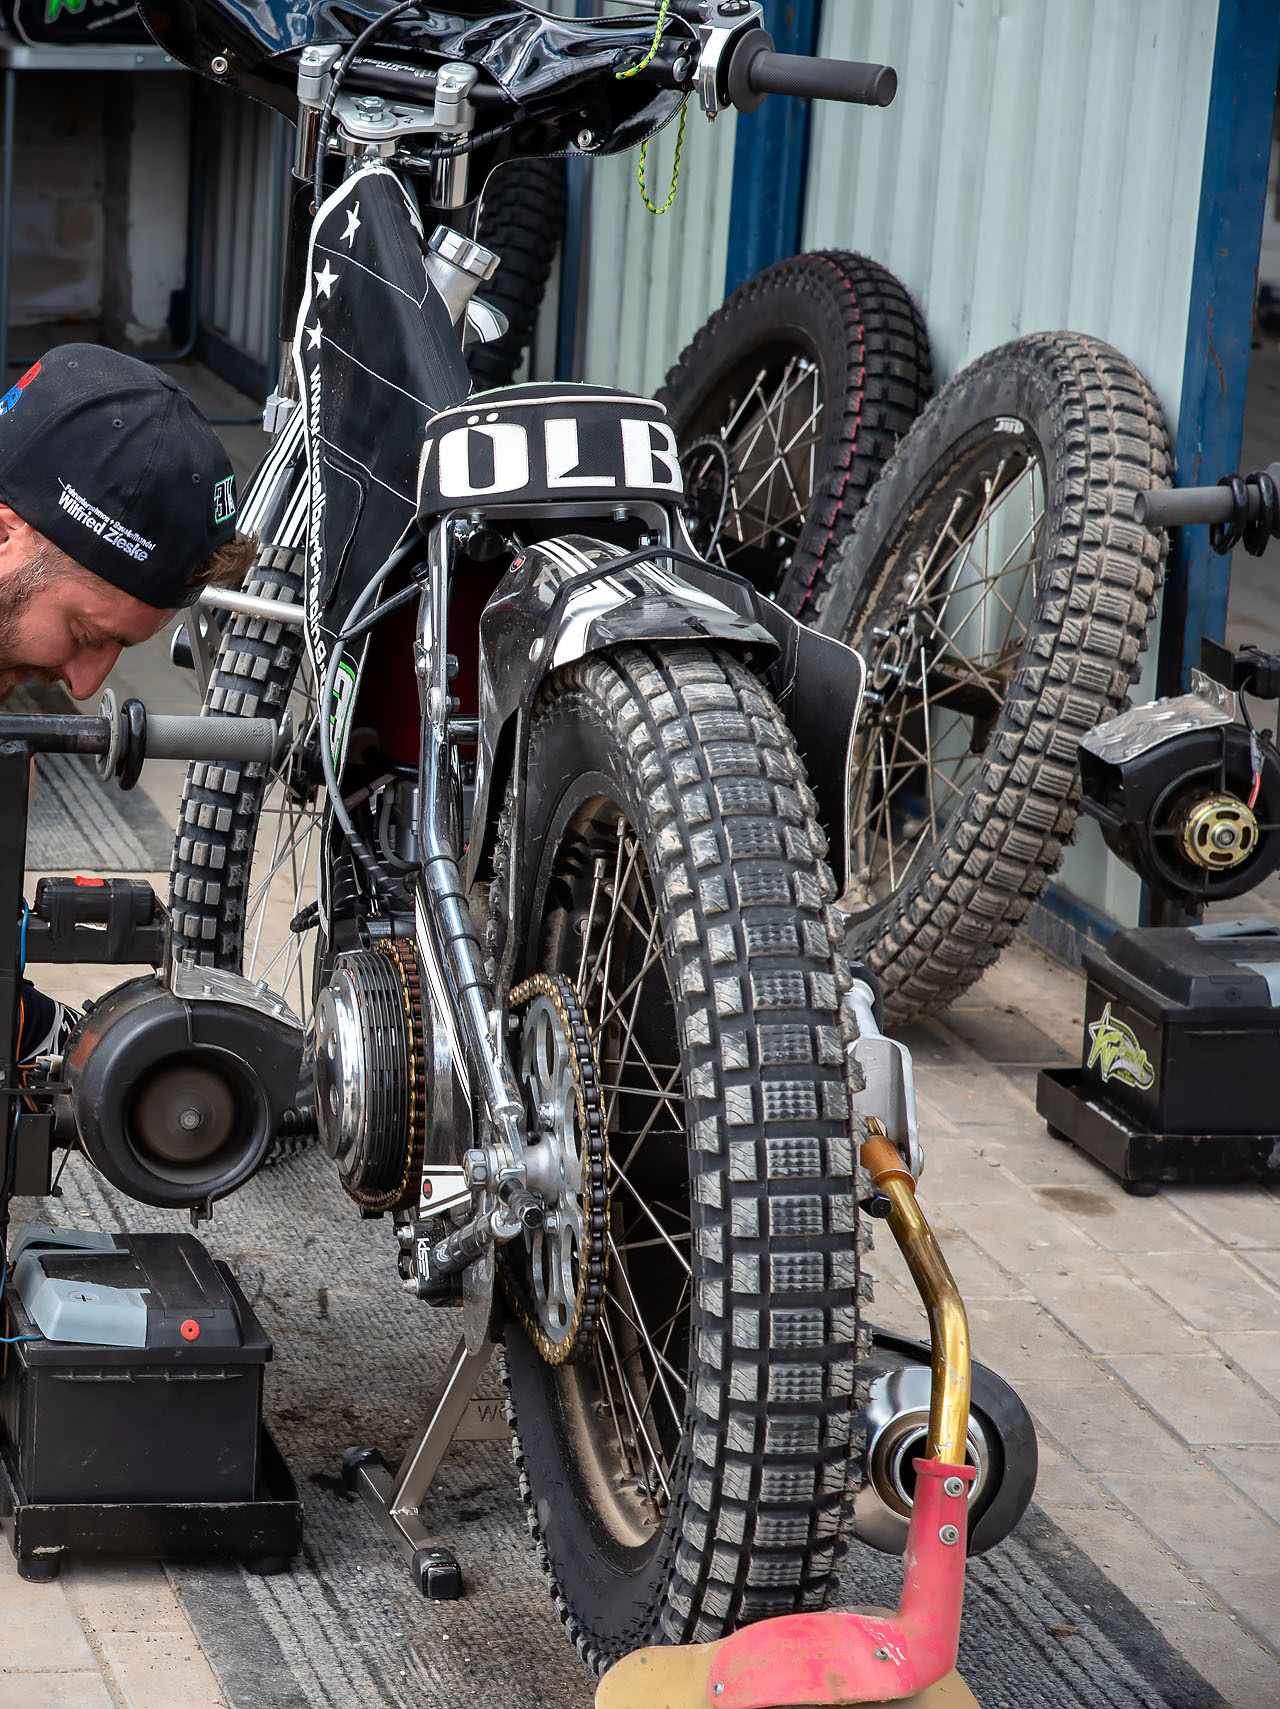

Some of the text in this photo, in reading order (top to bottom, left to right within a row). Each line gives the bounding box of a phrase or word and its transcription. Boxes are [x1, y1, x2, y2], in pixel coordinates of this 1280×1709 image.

[417, 412, 683, 499] ÖLB
[58, 490, 149, 562] Wilfried Zieske
